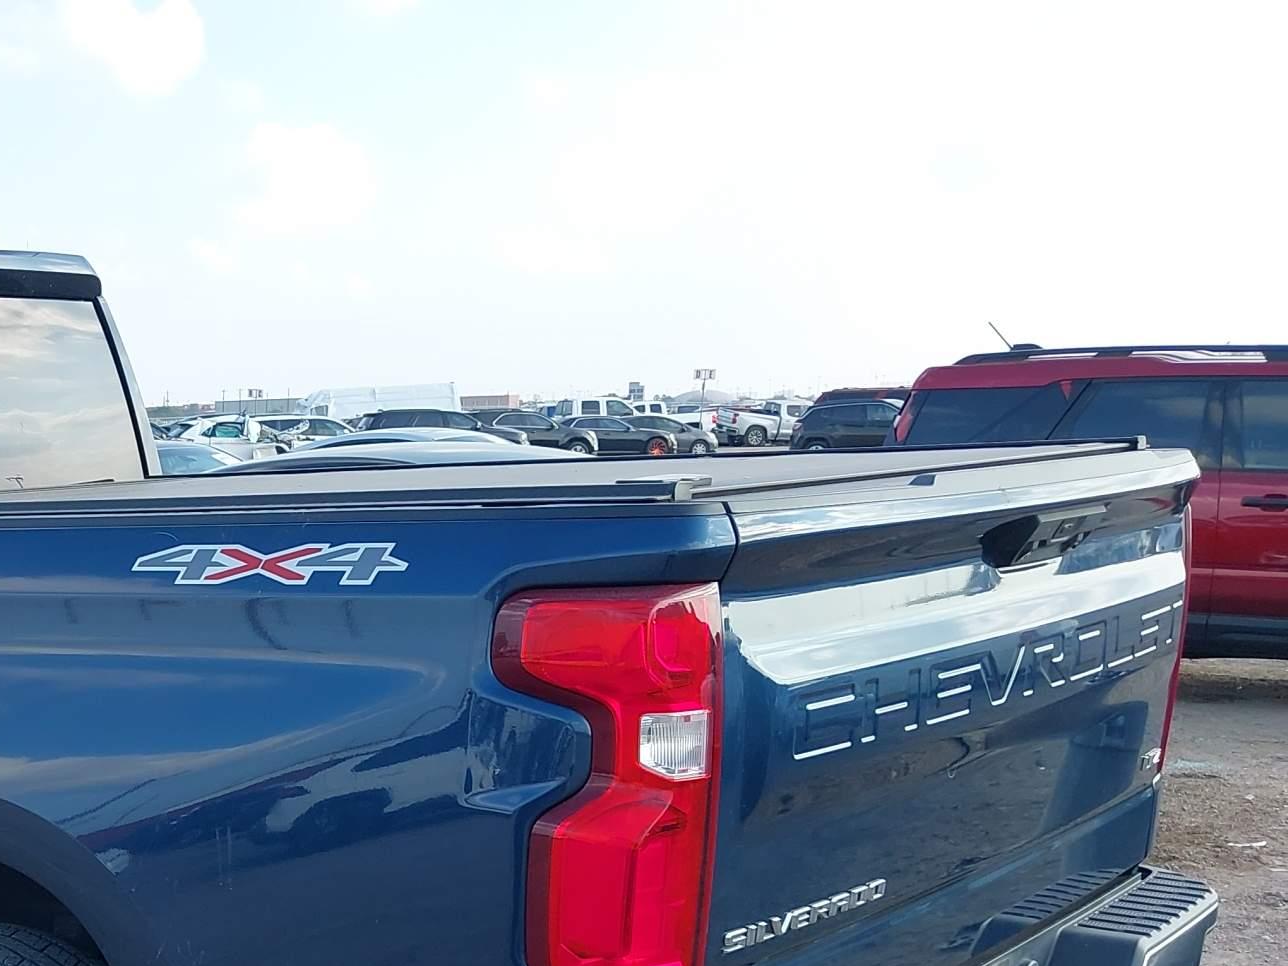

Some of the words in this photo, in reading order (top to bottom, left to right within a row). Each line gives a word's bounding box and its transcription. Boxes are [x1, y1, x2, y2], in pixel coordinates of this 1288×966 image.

[131, 543, 409, 585] 4X4
[793, 600, 1183, 760] CHEVROLET
[721, 877, 887, 954] SILVERADO
